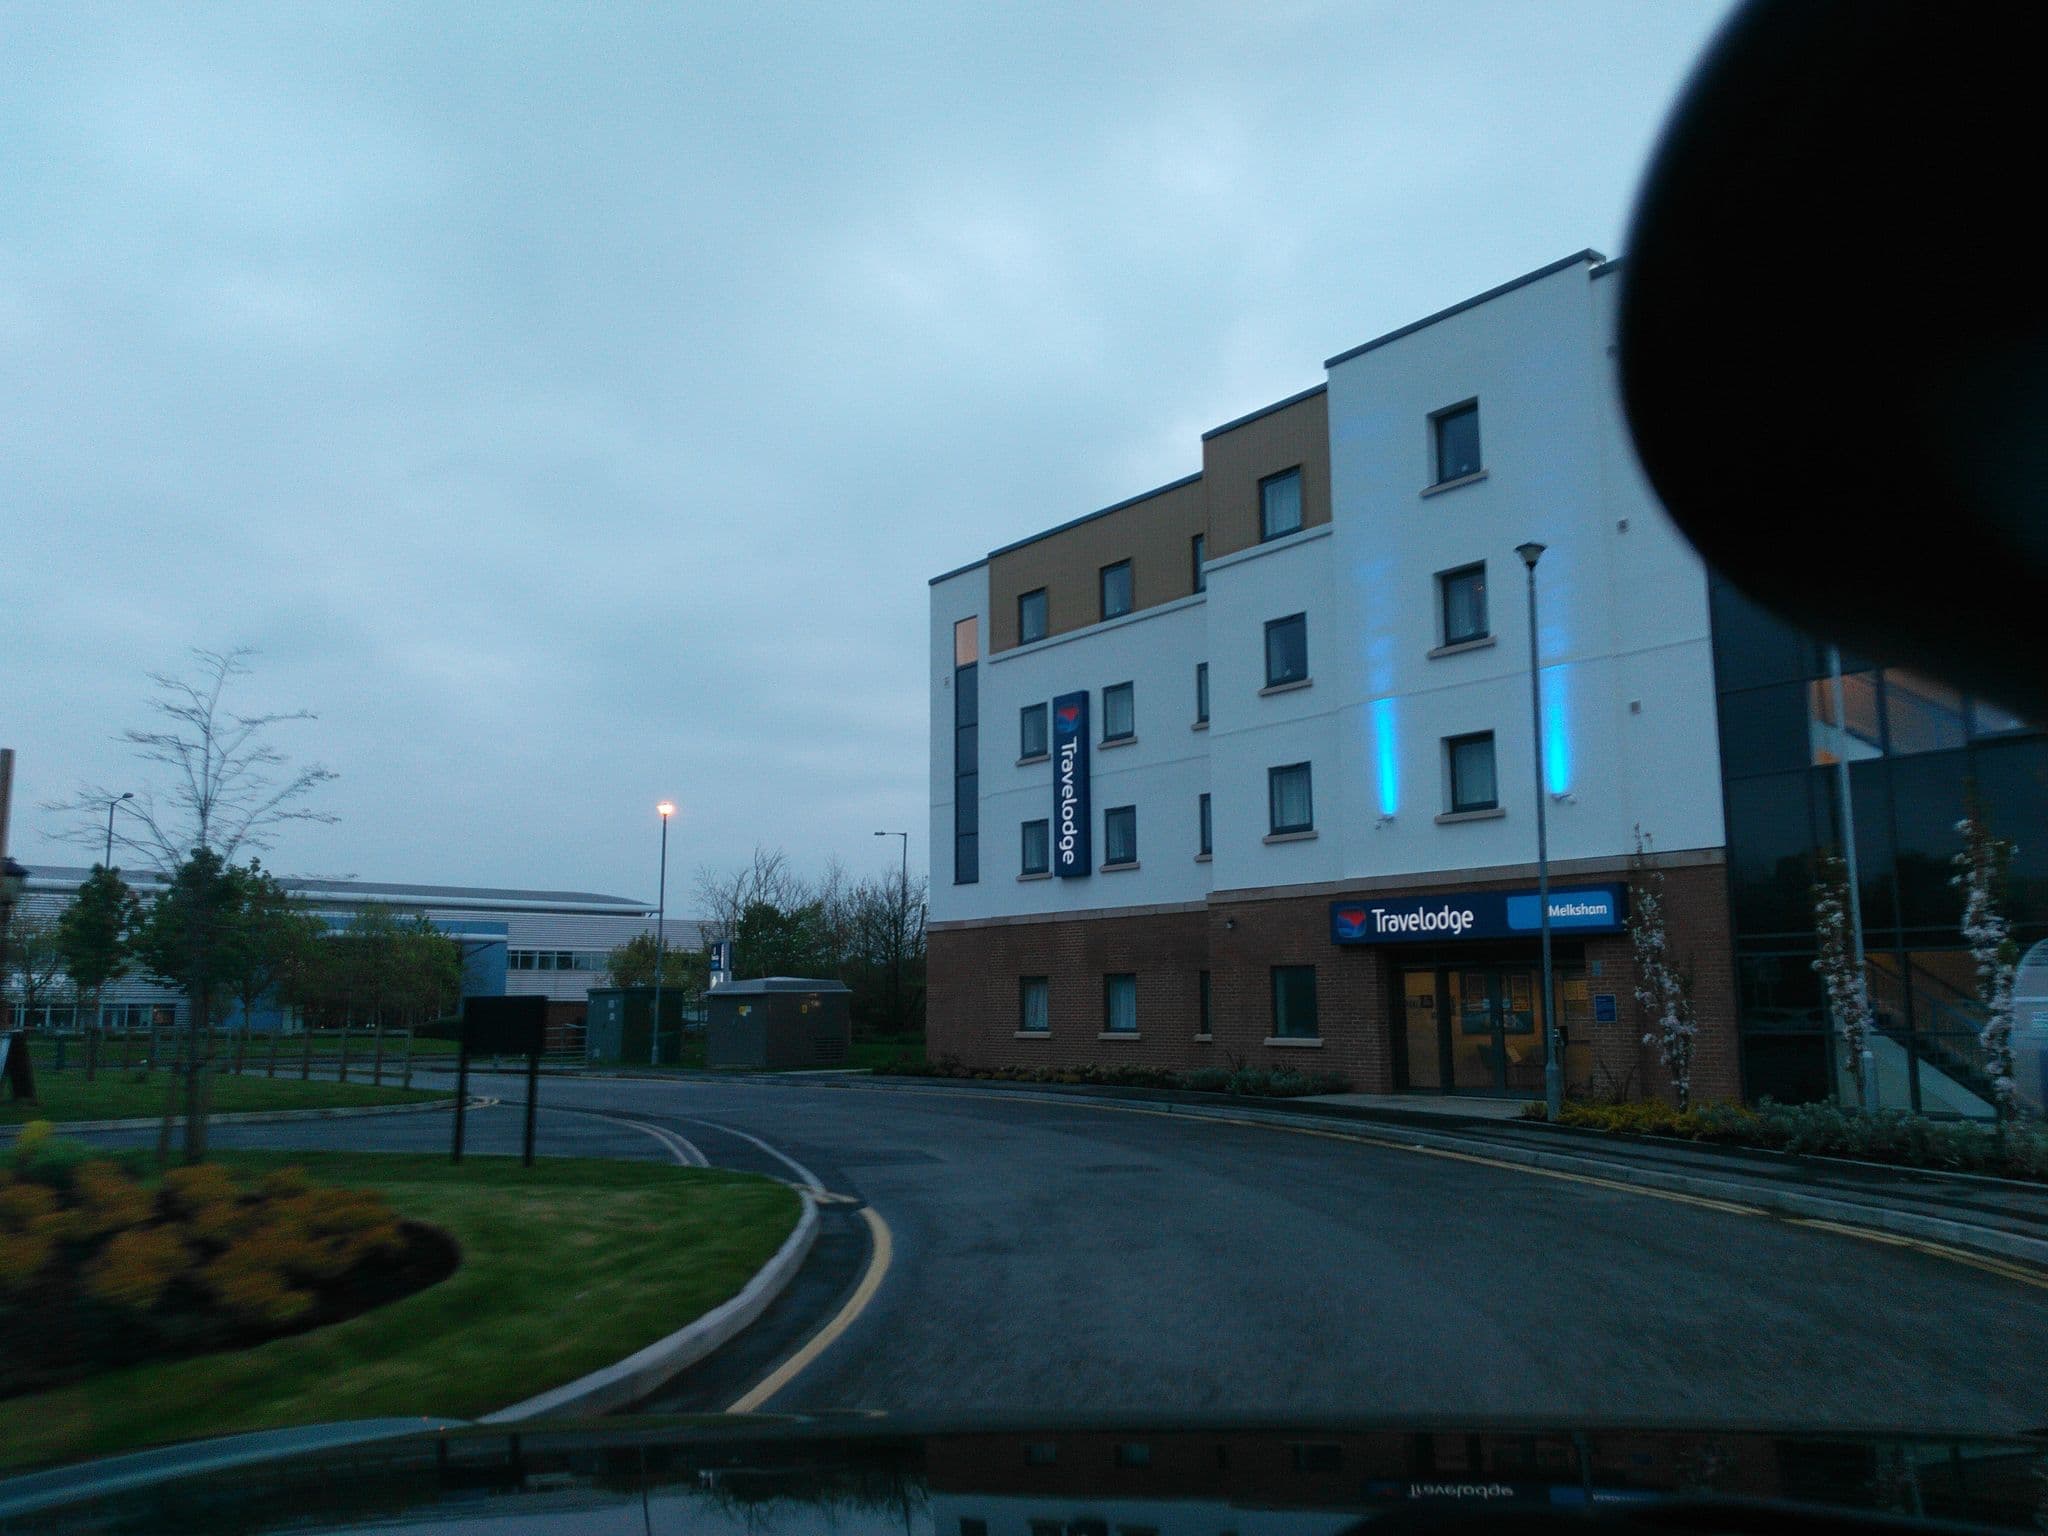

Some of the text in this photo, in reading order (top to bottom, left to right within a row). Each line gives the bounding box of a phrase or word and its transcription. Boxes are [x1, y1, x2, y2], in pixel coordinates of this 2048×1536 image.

[1059, 736, 1078, 864] Travelodge
[1371, 905, 1473, 935] Travelodge
[1548, 903, 1607, 917] Melksham
